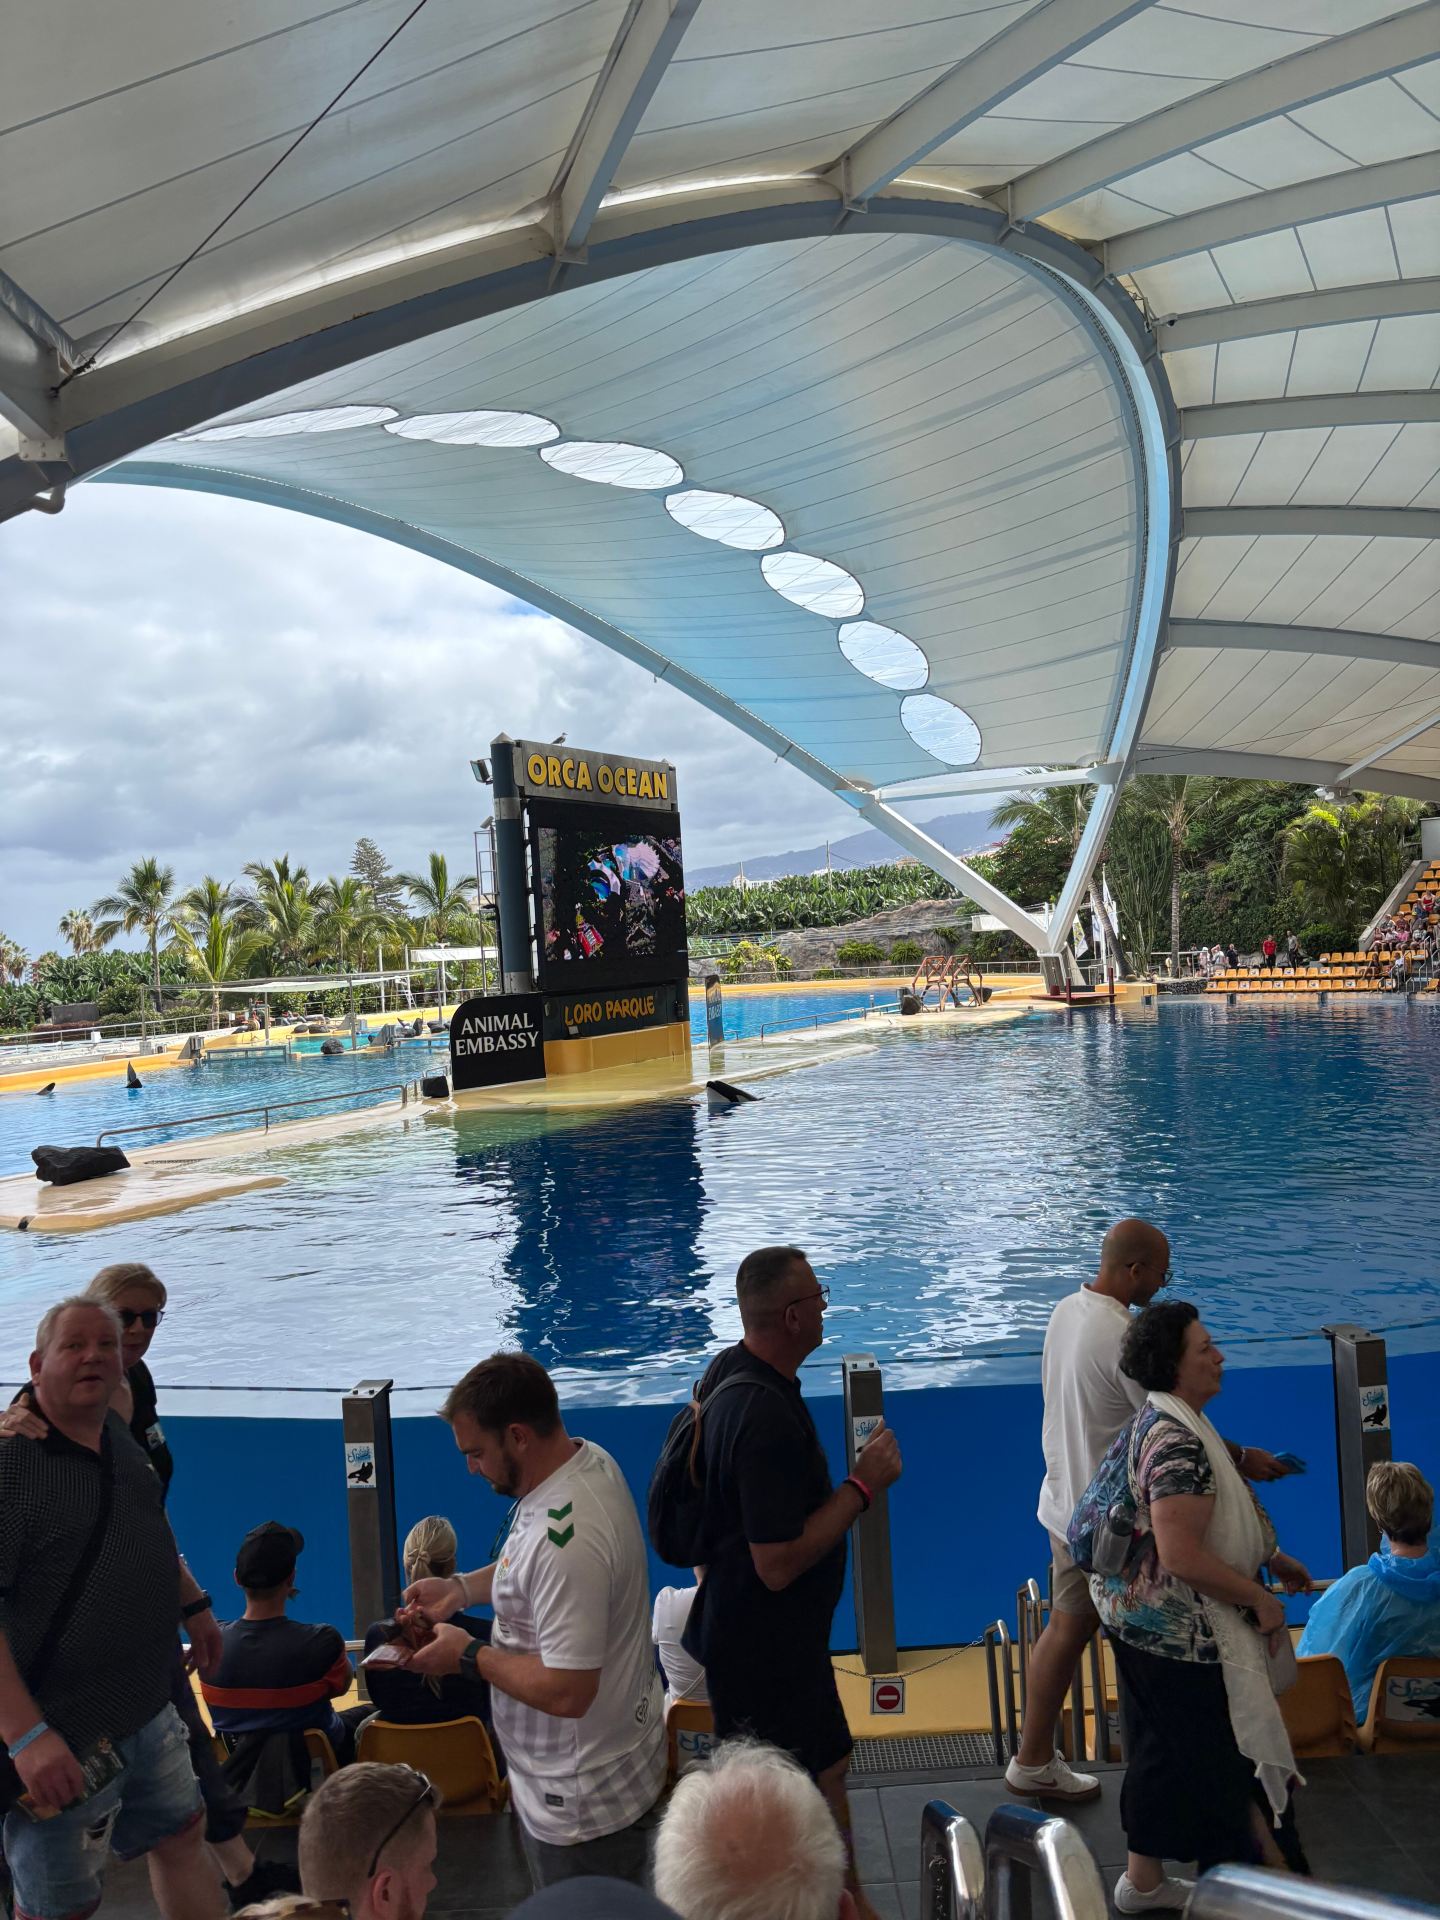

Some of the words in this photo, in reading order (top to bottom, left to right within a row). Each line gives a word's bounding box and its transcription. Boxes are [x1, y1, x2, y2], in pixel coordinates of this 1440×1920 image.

[527, 753, 593, 791] ORCA
[597, 764, 668, 799] OCEAN
[461, 1012, 534, 1035] ANIMAL
[565, 1001, 602, 1026] LORO
[606, 995, 656, 1019] PARQUE
[455, 1031, 540, 1056] EMBASSY
